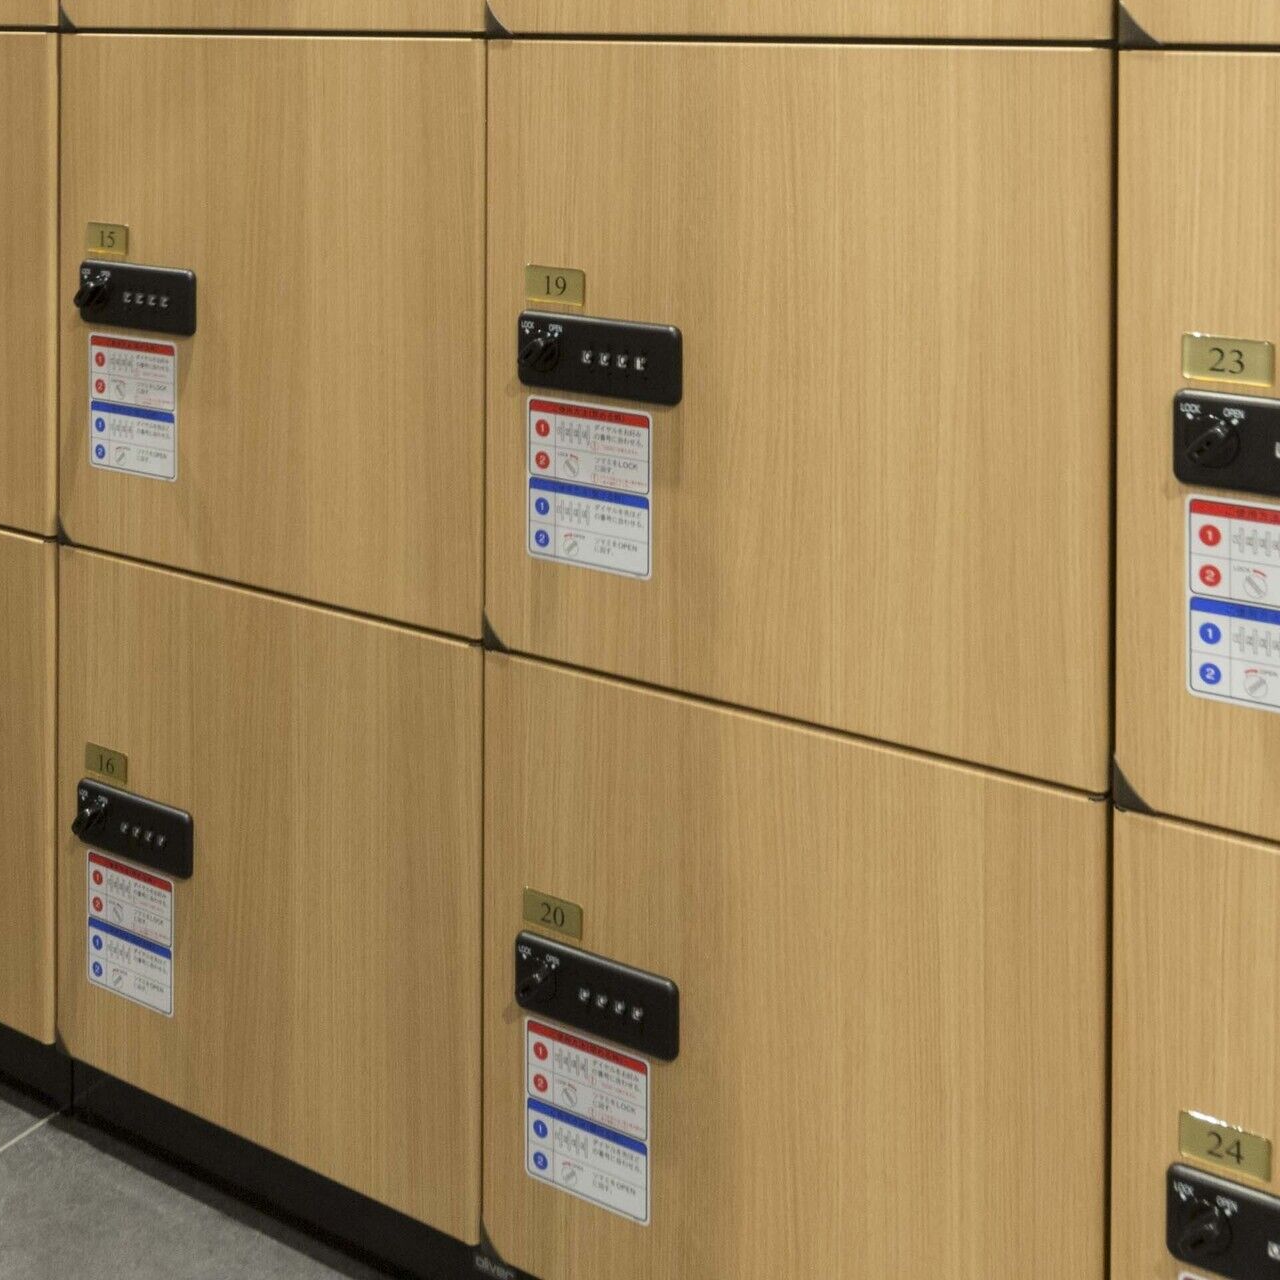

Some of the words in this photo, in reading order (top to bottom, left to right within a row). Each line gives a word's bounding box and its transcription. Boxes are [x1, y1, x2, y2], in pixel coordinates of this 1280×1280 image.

[99, 230, 116, 248] 15
[545, 275, 567, 296] 19
[521, 320, 535, 329] LOCK
[548, 323, 563, 333] OPEN
[1208, 348, 1245, 374] 23
[1180, 403, 1201, 414] LOCK
[1223, 407, 1245, 419] OPEN
[97, 753, 115, 774] 16
[539, 902, 565, 928] 20
[518, 944, 532, 956] LOCK
[545, 954, 560, 965] OPEN
[1207, 1132, 1245, 1165] 24
